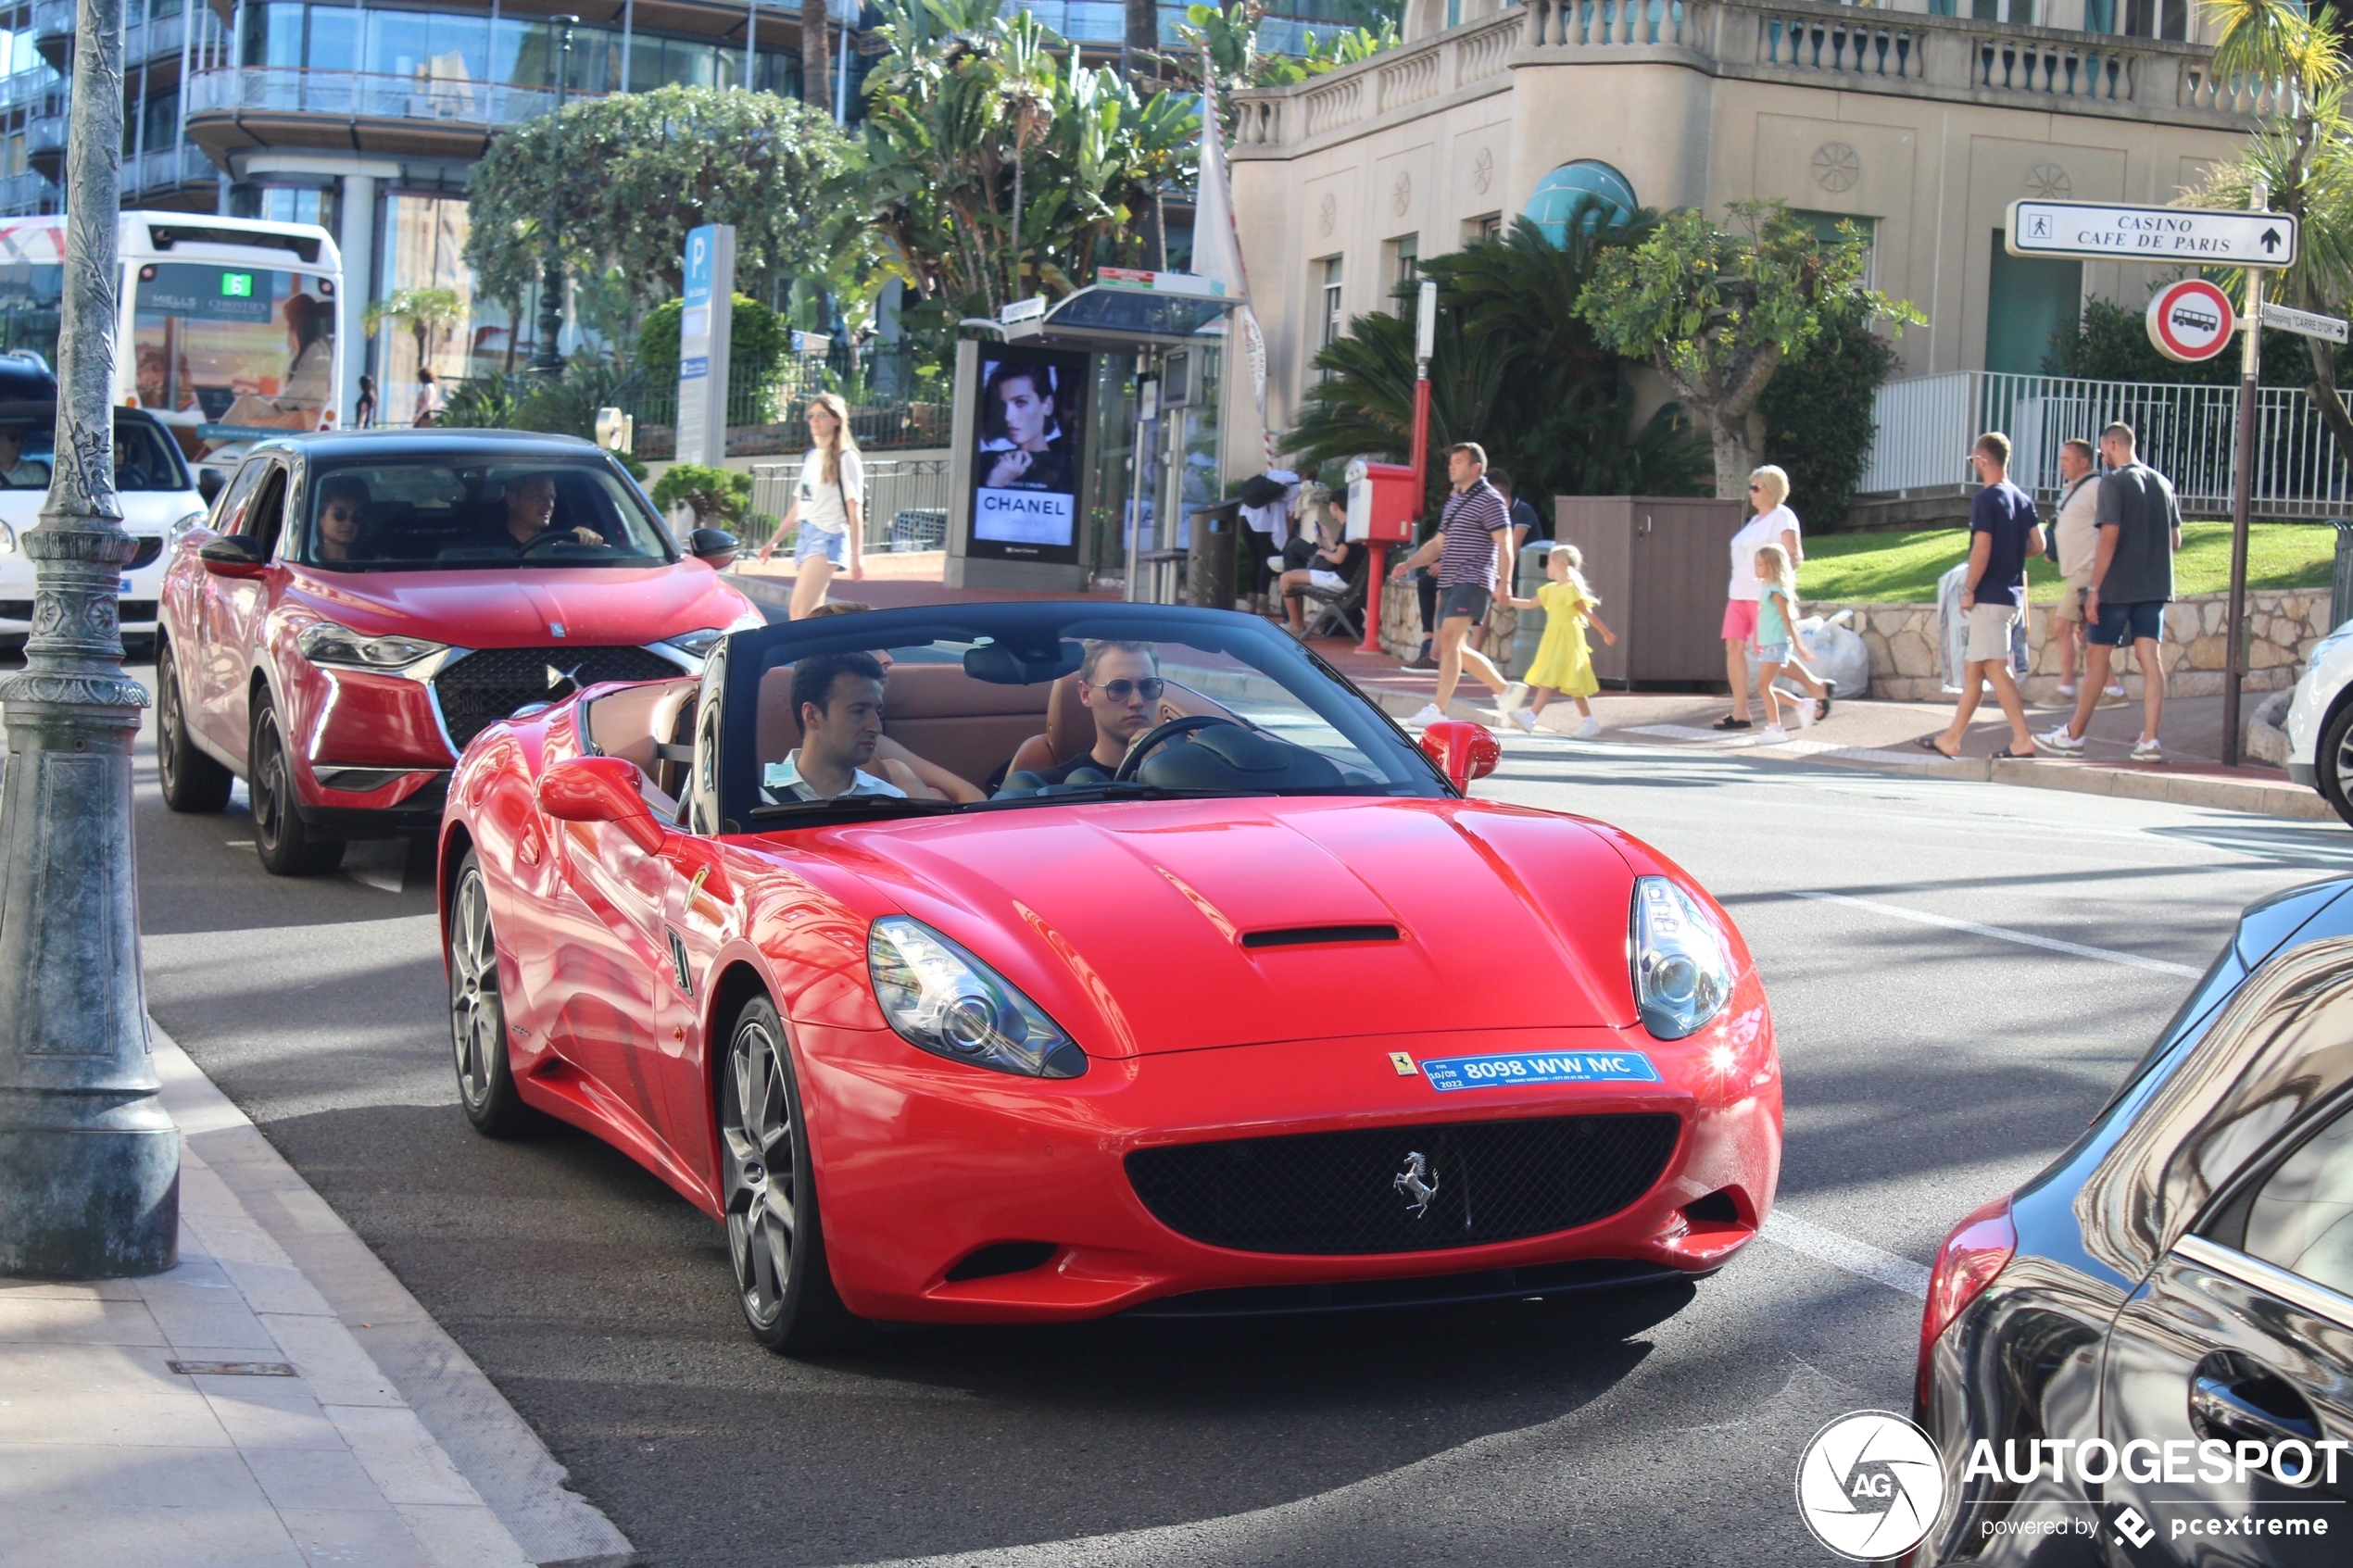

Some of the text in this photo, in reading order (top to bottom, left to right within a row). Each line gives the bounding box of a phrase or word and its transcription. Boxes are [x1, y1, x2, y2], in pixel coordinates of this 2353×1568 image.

[2118, 216, 2193, 232] CASINO
[2078, 231, 2231, 252] CAFE DE PARIS
[692, 236, 705, 279] P
[2265, 309, 2291, 328] Shopping
[984, 496, 1065, 515] CHANEL
[1429, 1070, 1457, 1081] 10/08
[1464, 1057, 1630, 1079] 8098 WW MC
[1441, 1080, 1464, 1088] 2022
